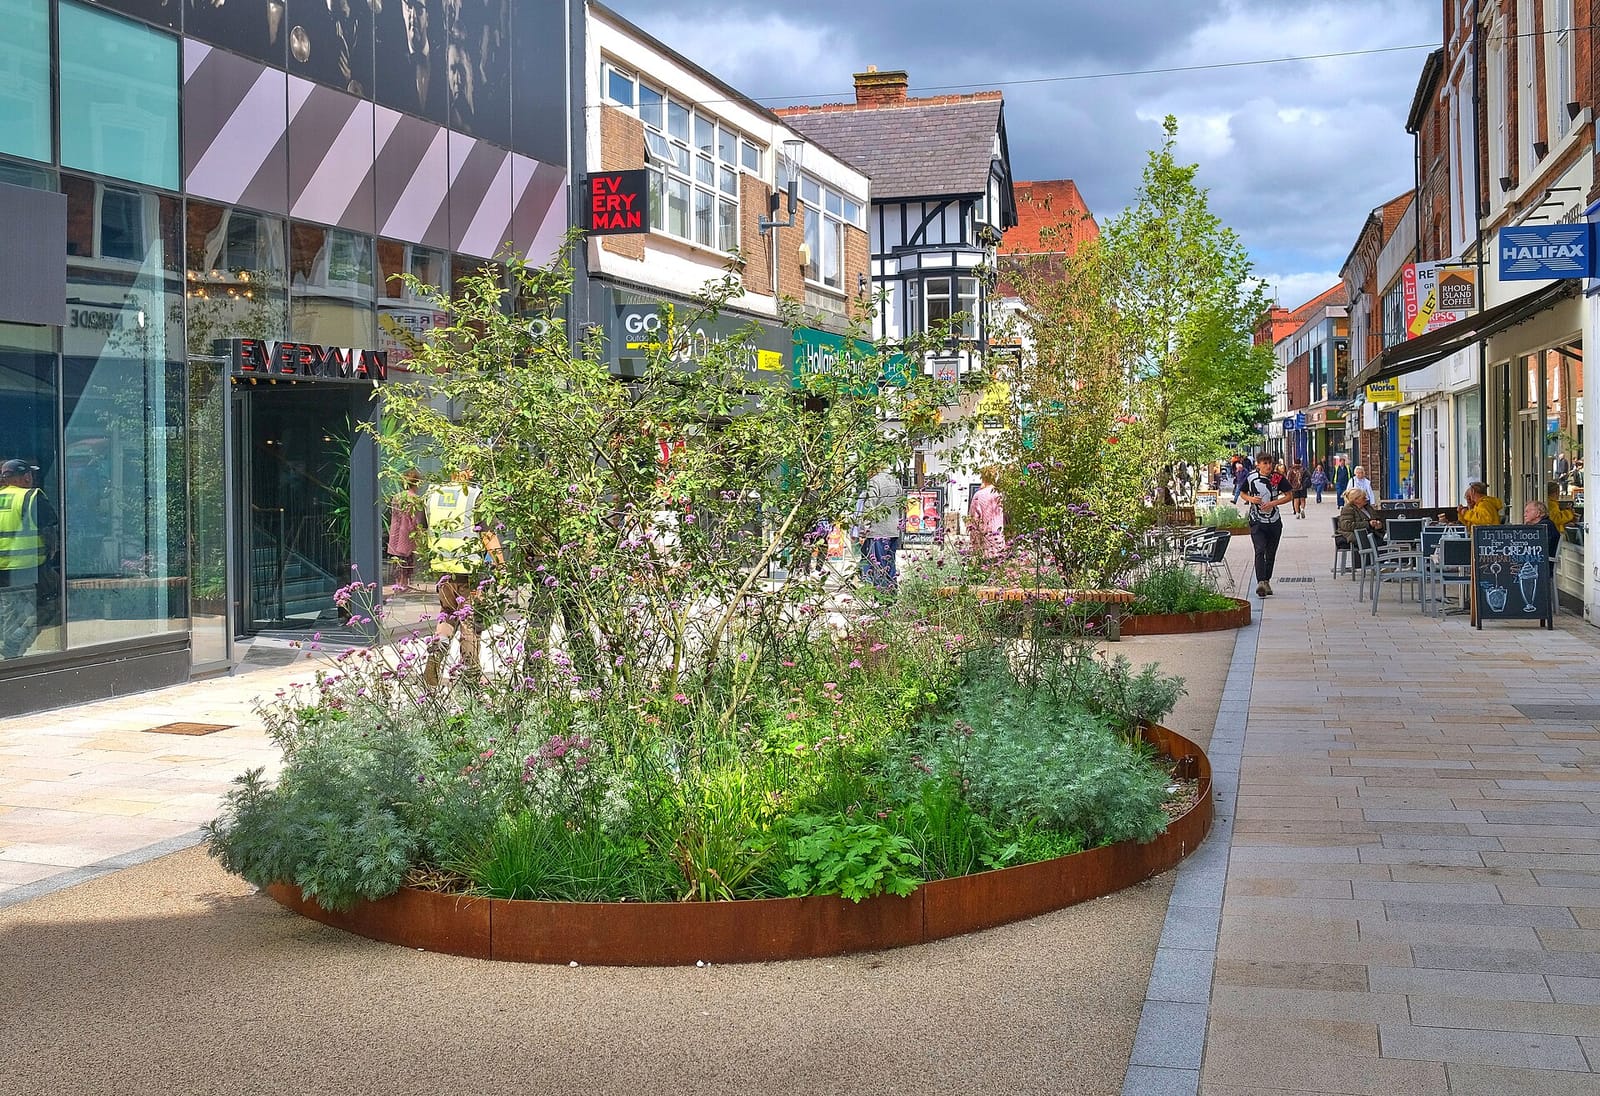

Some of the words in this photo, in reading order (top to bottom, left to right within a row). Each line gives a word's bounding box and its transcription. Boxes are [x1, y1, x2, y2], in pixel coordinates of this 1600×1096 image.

[592, 176, 622, 195] EV
[592, 193, 637, 212] ERY
[592, 211, 641, 230] MAN
[1503, 244, 1585, 260] HALIFAX
[1405, 281, 1416, 301] LET
[1442, 284, 1472, 293] RHODE
[1442, 291, 1472, 300] ISLAND
[1422, 294, 1437, 316] LET
[1442, 298, 1472, 306] COFFEE
[1407, 304, 1417, 319] TO
[625, 313, 661, 334] GO
[240, 338, 387, 381] EVERYMAN
[1495, 530, 1512, 540] The
[1513, 530, 1540, 540] Mood
[1479, 545, 1542, 556] ICE-CREAM?
